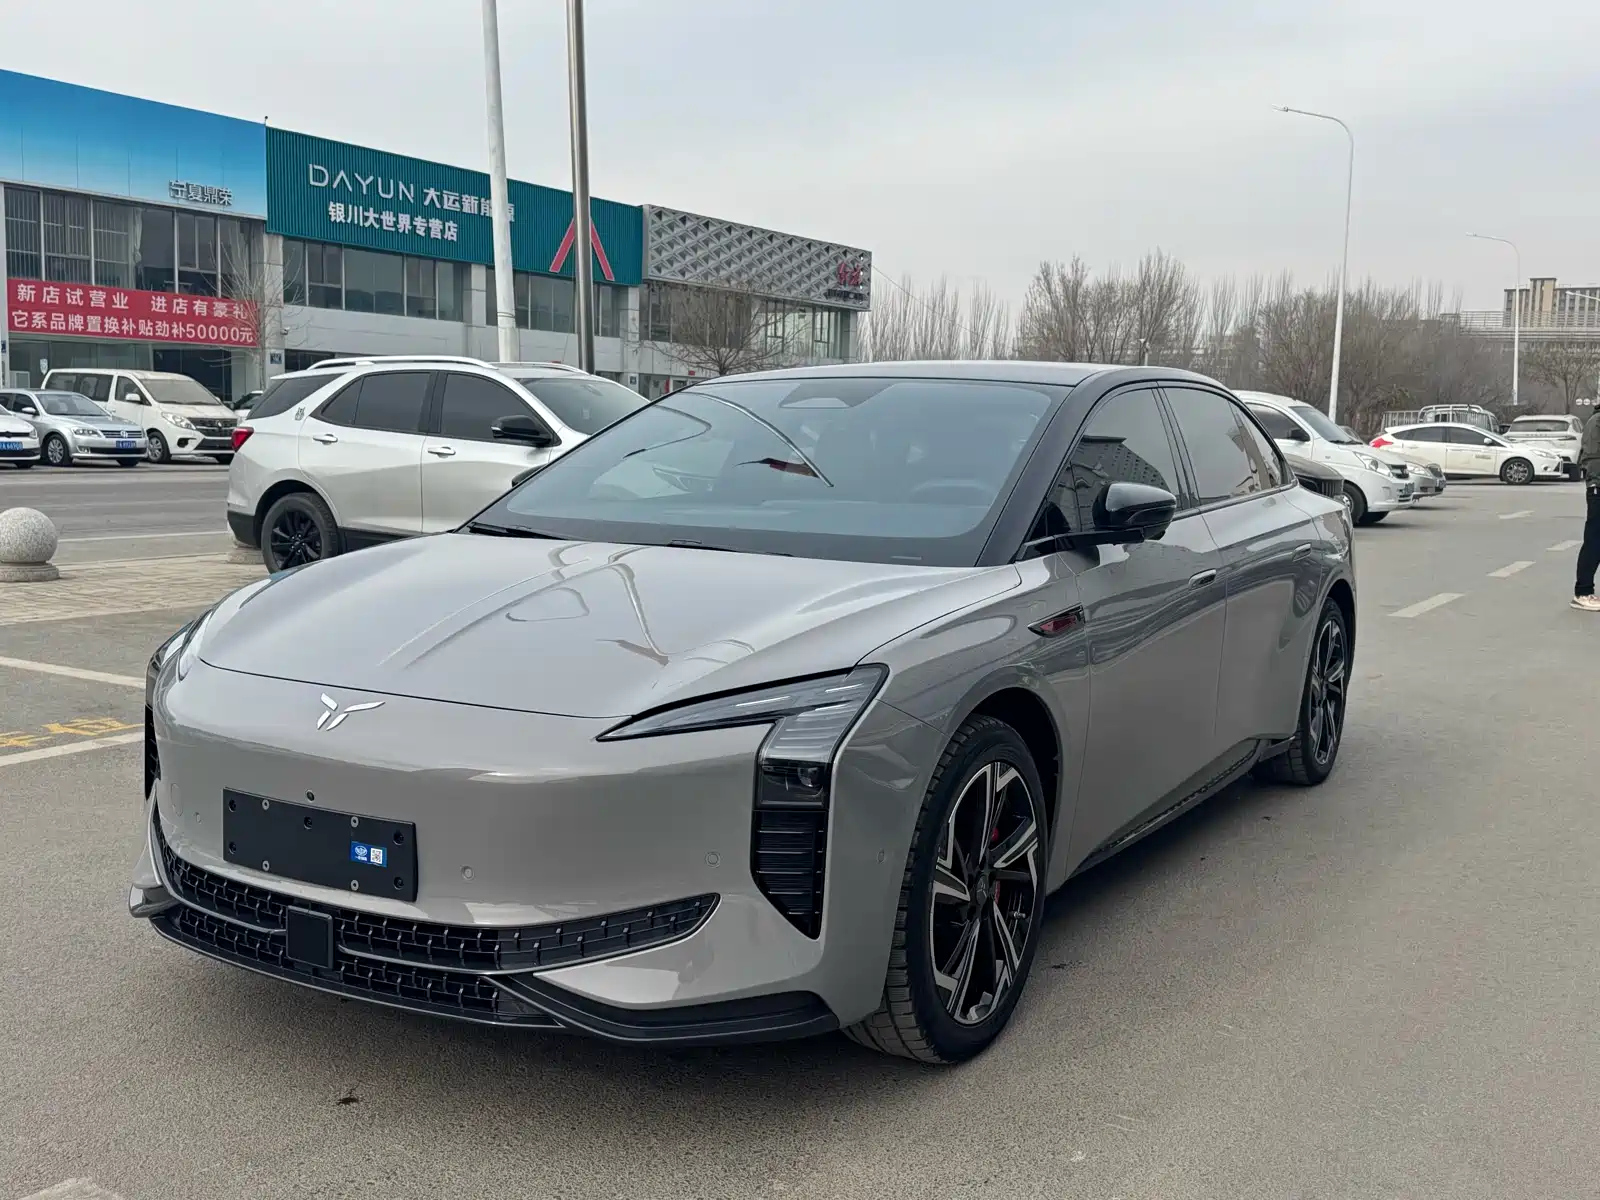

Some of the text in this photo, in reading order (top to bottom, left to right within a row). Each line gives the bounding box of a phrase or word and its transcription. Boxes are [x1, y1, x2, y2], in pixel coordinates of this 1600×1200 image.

[169, 180, 232, 206] 宁夏鼎荣
[309, 163, 414, 203] DAYUN
[328, 201, 457, 241] 银川大世界专营店
[17, 284, 248, 319] 新店试营业 进店有豪礼
[12, 310, 253, 342] 它系品牌置换补贴劲补50000元
